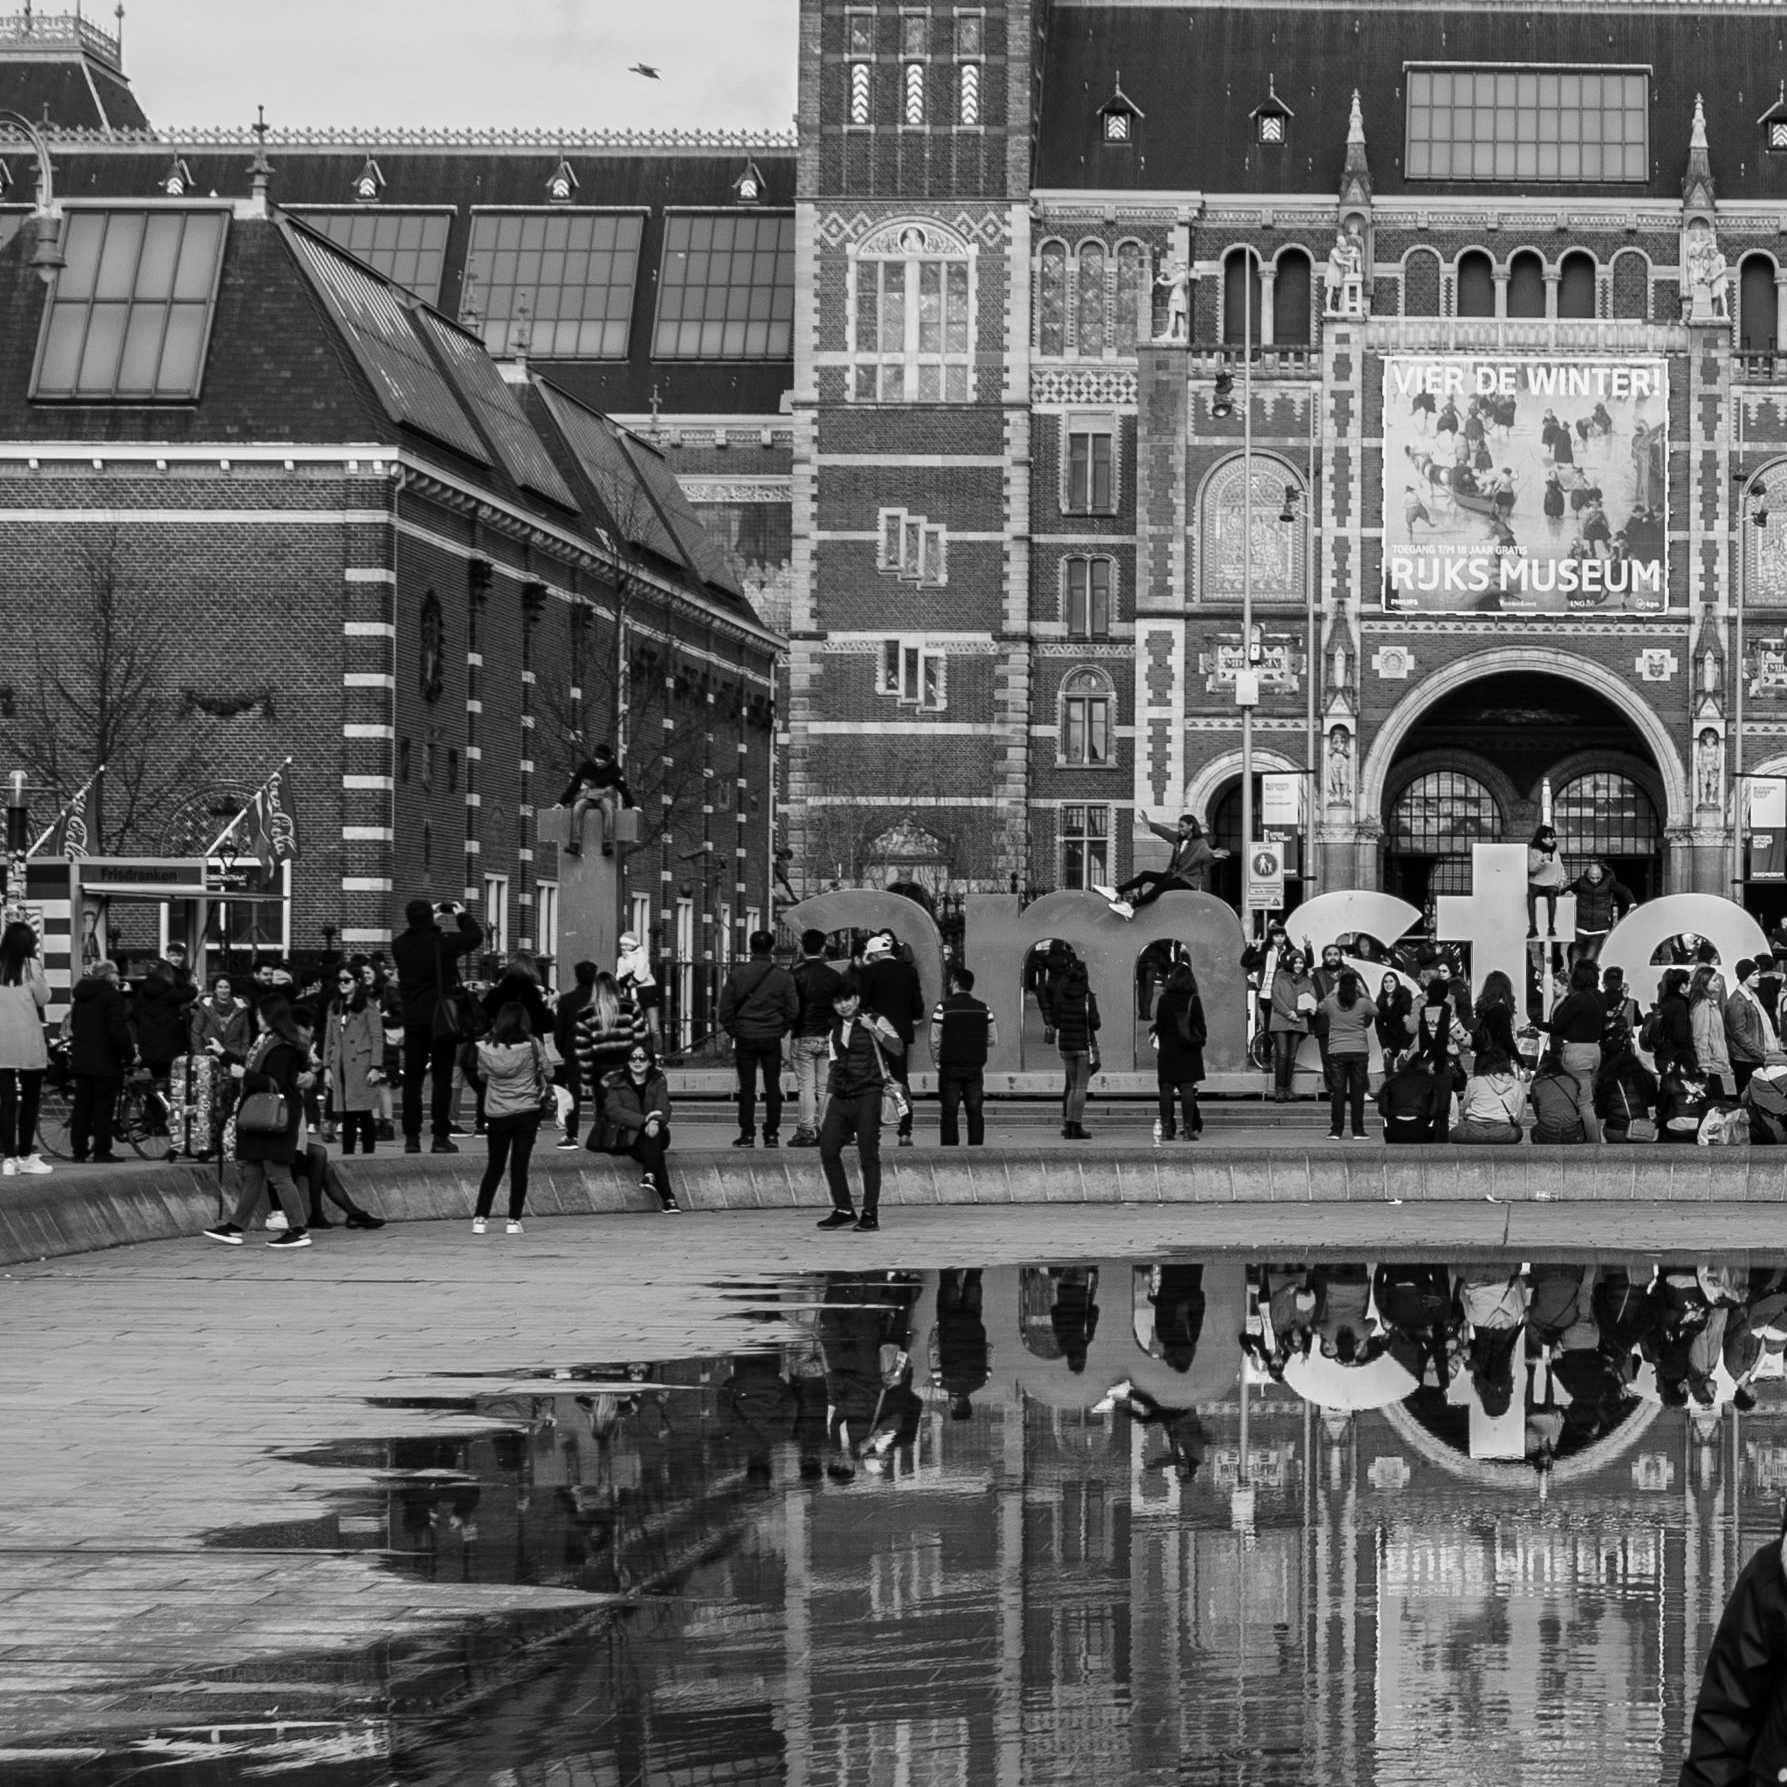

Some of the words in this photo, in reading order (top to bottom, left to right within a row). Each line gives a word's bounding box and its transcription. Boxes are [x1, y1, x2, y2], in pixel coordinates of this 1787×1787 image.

[1392, 366, 1464, 395] VIER
[1476, 366, 1516, 395] DE
[1526, 367, 1660, 397] WINTER!
[1392, 544, 1435, 554] TOEGANG
[1438, 545, 1454, 554] T/M
[1457, 545, 1467, 554] 18
[1470, 545, 1493, 555] JAAR
[1495, 545, 1528, 555] GRATIS
[1392, 558, 1489, 591] RIJKS
[1500, 559, 1660, 592] MUSEUM
[101, 867, 177, 881] Frisdranken
